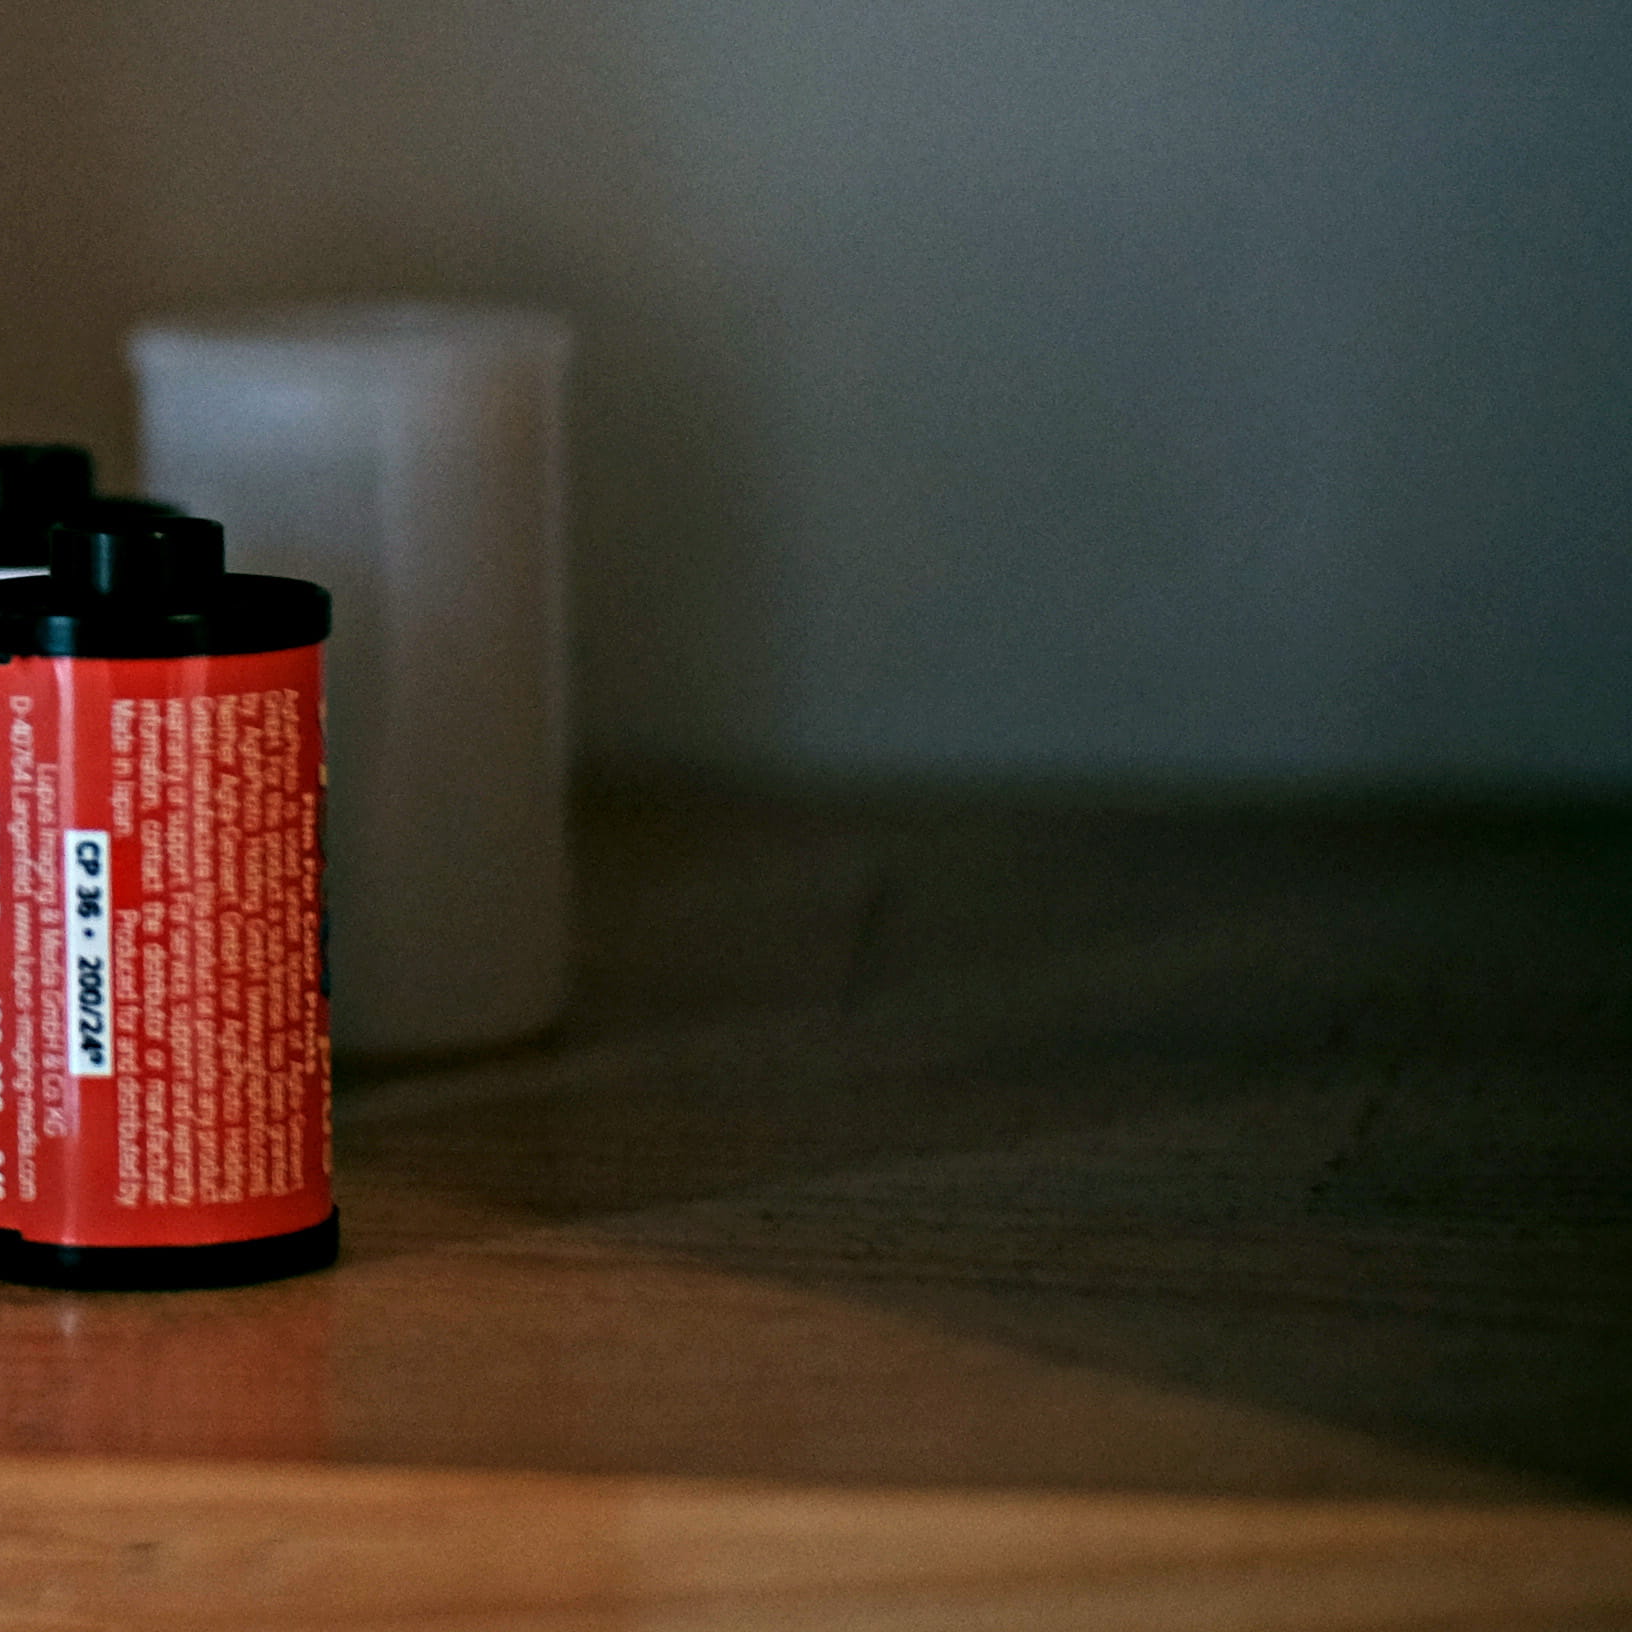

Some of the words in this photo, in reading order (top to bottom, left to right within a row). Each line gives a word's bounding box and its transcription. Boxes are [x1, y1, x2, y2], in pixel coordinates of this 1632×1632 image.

[111, 699, 135, 754] Made
[112, 758, 134, 775] in
[33, 763, 58, 824] Lupus
[76, 840, 101, 876] CP
[303, 858, 316, 902] For
[76, 885, 103, 919] 36
[40, 928, 65, 986] Media
[114, 909, 142, 1000] Produced
[40, 988, 66, 1050] GmbH
[117, 1005, 144, 1033] for
[117, 1035, 144, 1073] and
